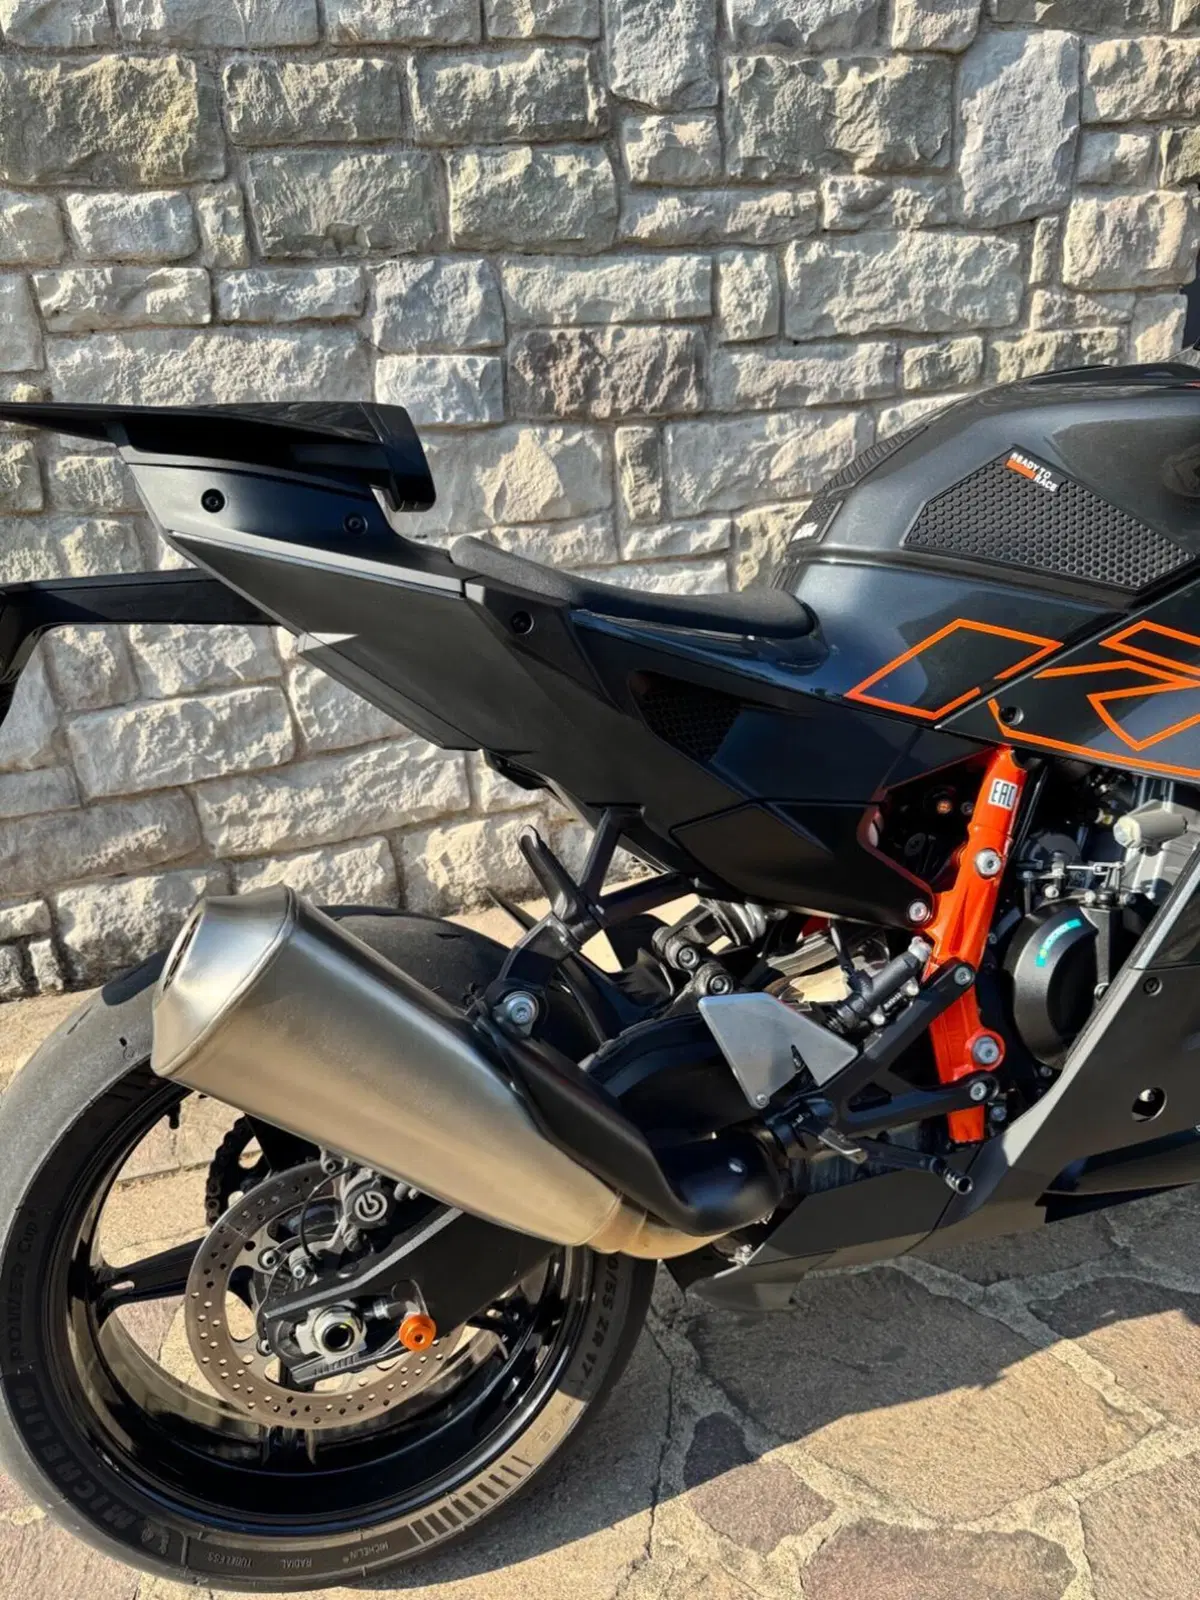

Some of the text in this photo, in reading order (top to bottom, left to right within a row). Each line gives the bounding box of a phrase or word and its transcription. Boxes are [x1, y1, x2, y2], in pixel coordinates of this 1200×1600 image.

[1010, 452, 1052, 479] READY TO
[1034, 475, 1058, 492] RACE
[8, 1262, 26, 1364] POWER
[592, 1315, 609, 1348] ZR
[581, 1352, 598, 1378] 17
[14, 1387, 139, 1532] MICHELIN
[279, 1556, 313, 1570] RADIAL
